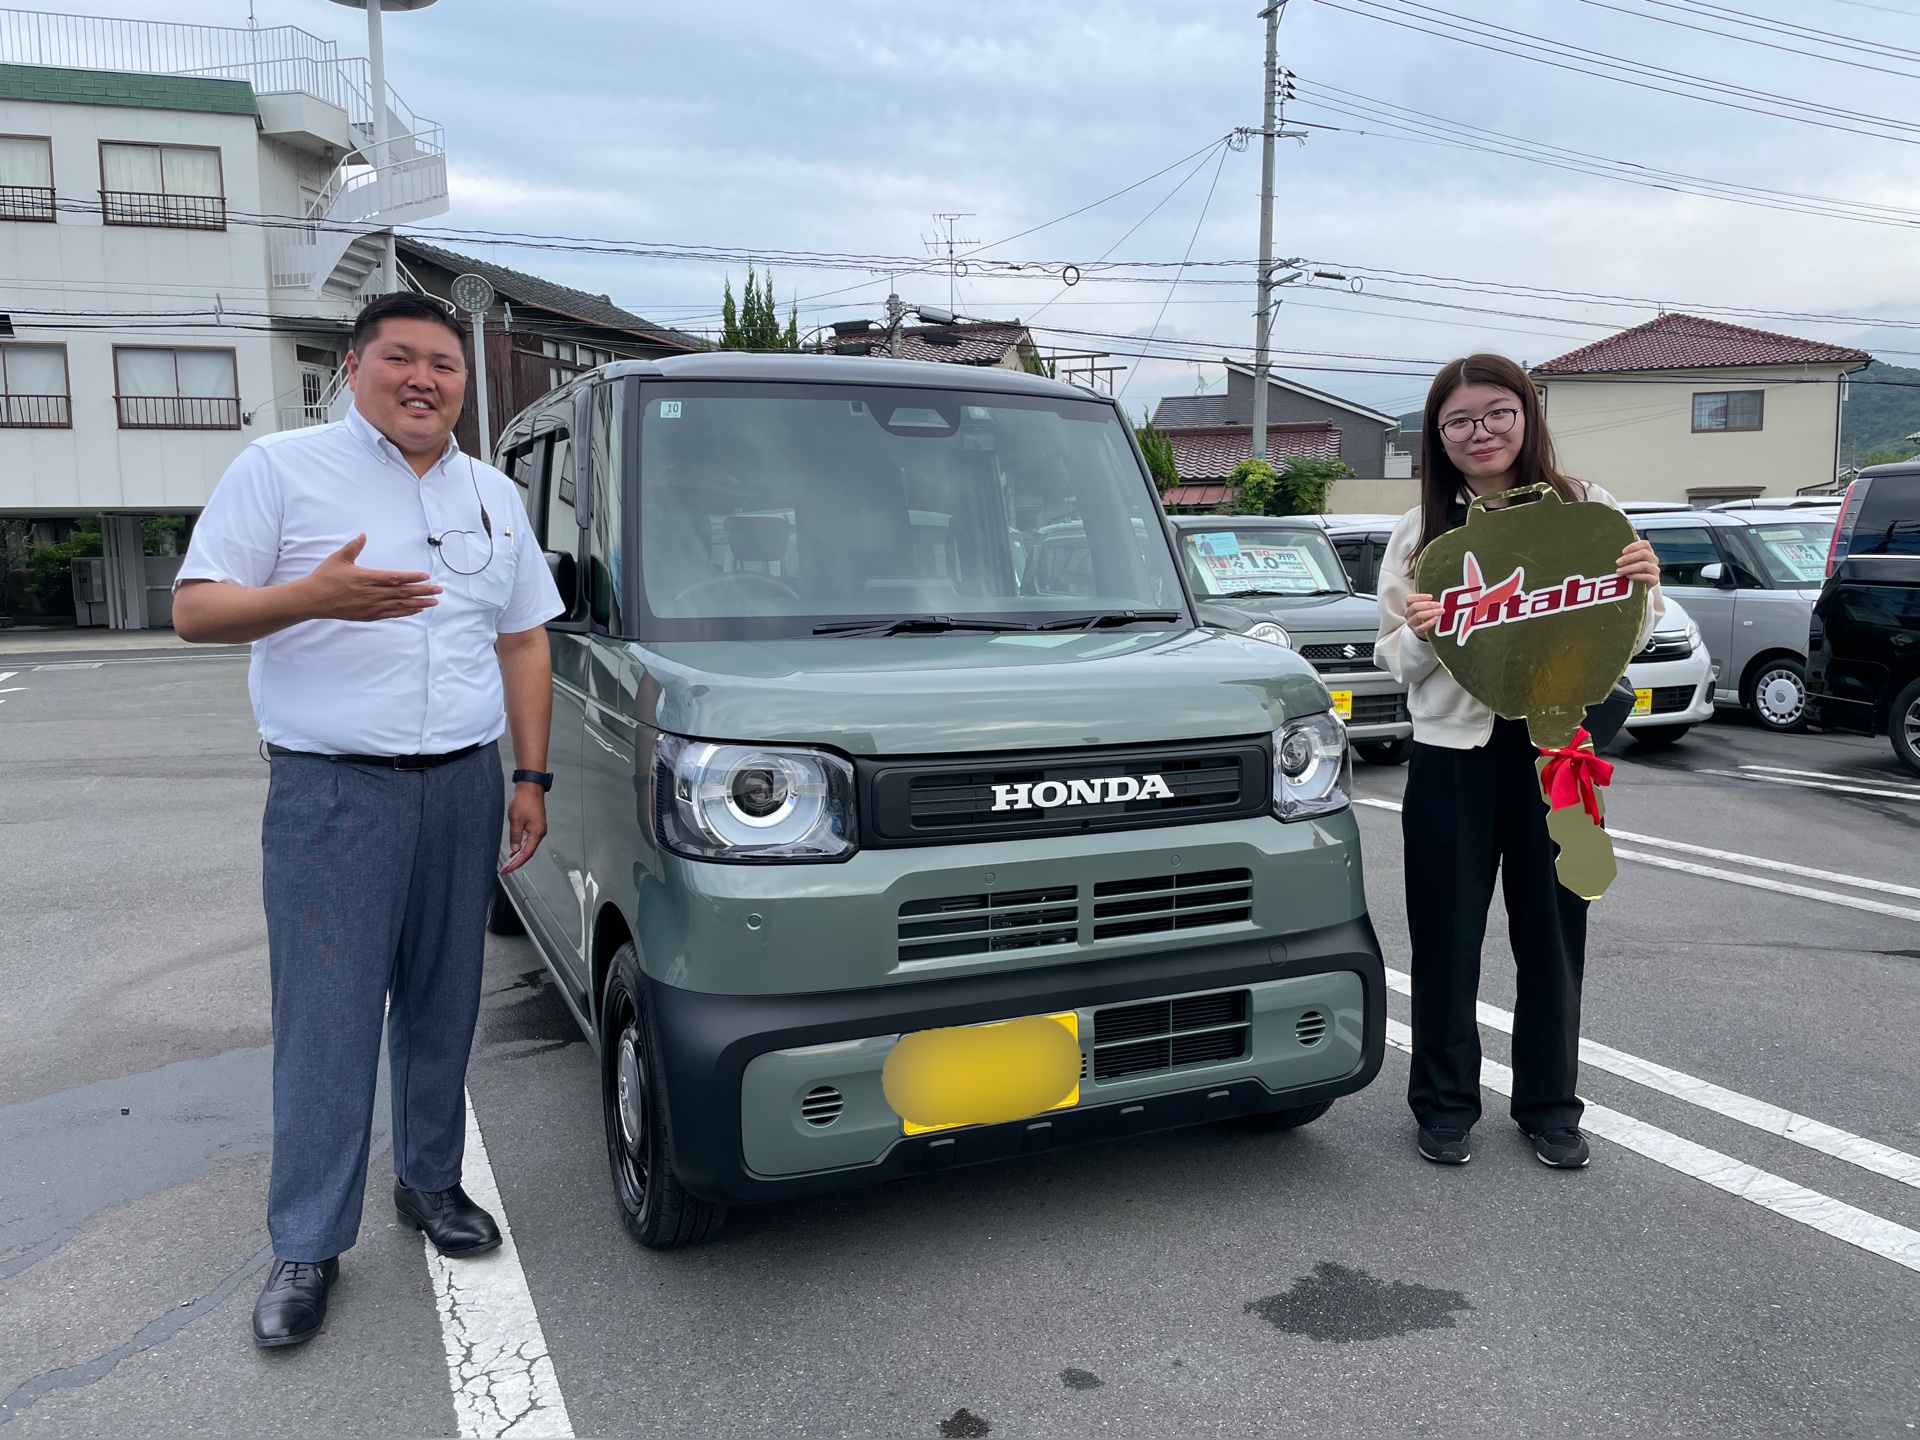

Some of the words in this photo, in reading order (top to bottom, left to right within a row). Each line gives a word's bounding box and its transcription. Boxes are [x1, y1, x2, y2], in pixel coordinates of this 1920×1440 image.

[668, 403, 679, 413] 10
[1438, 575, 1631, 634] Futaba
[991, 774, 1175, 811] HONDA
